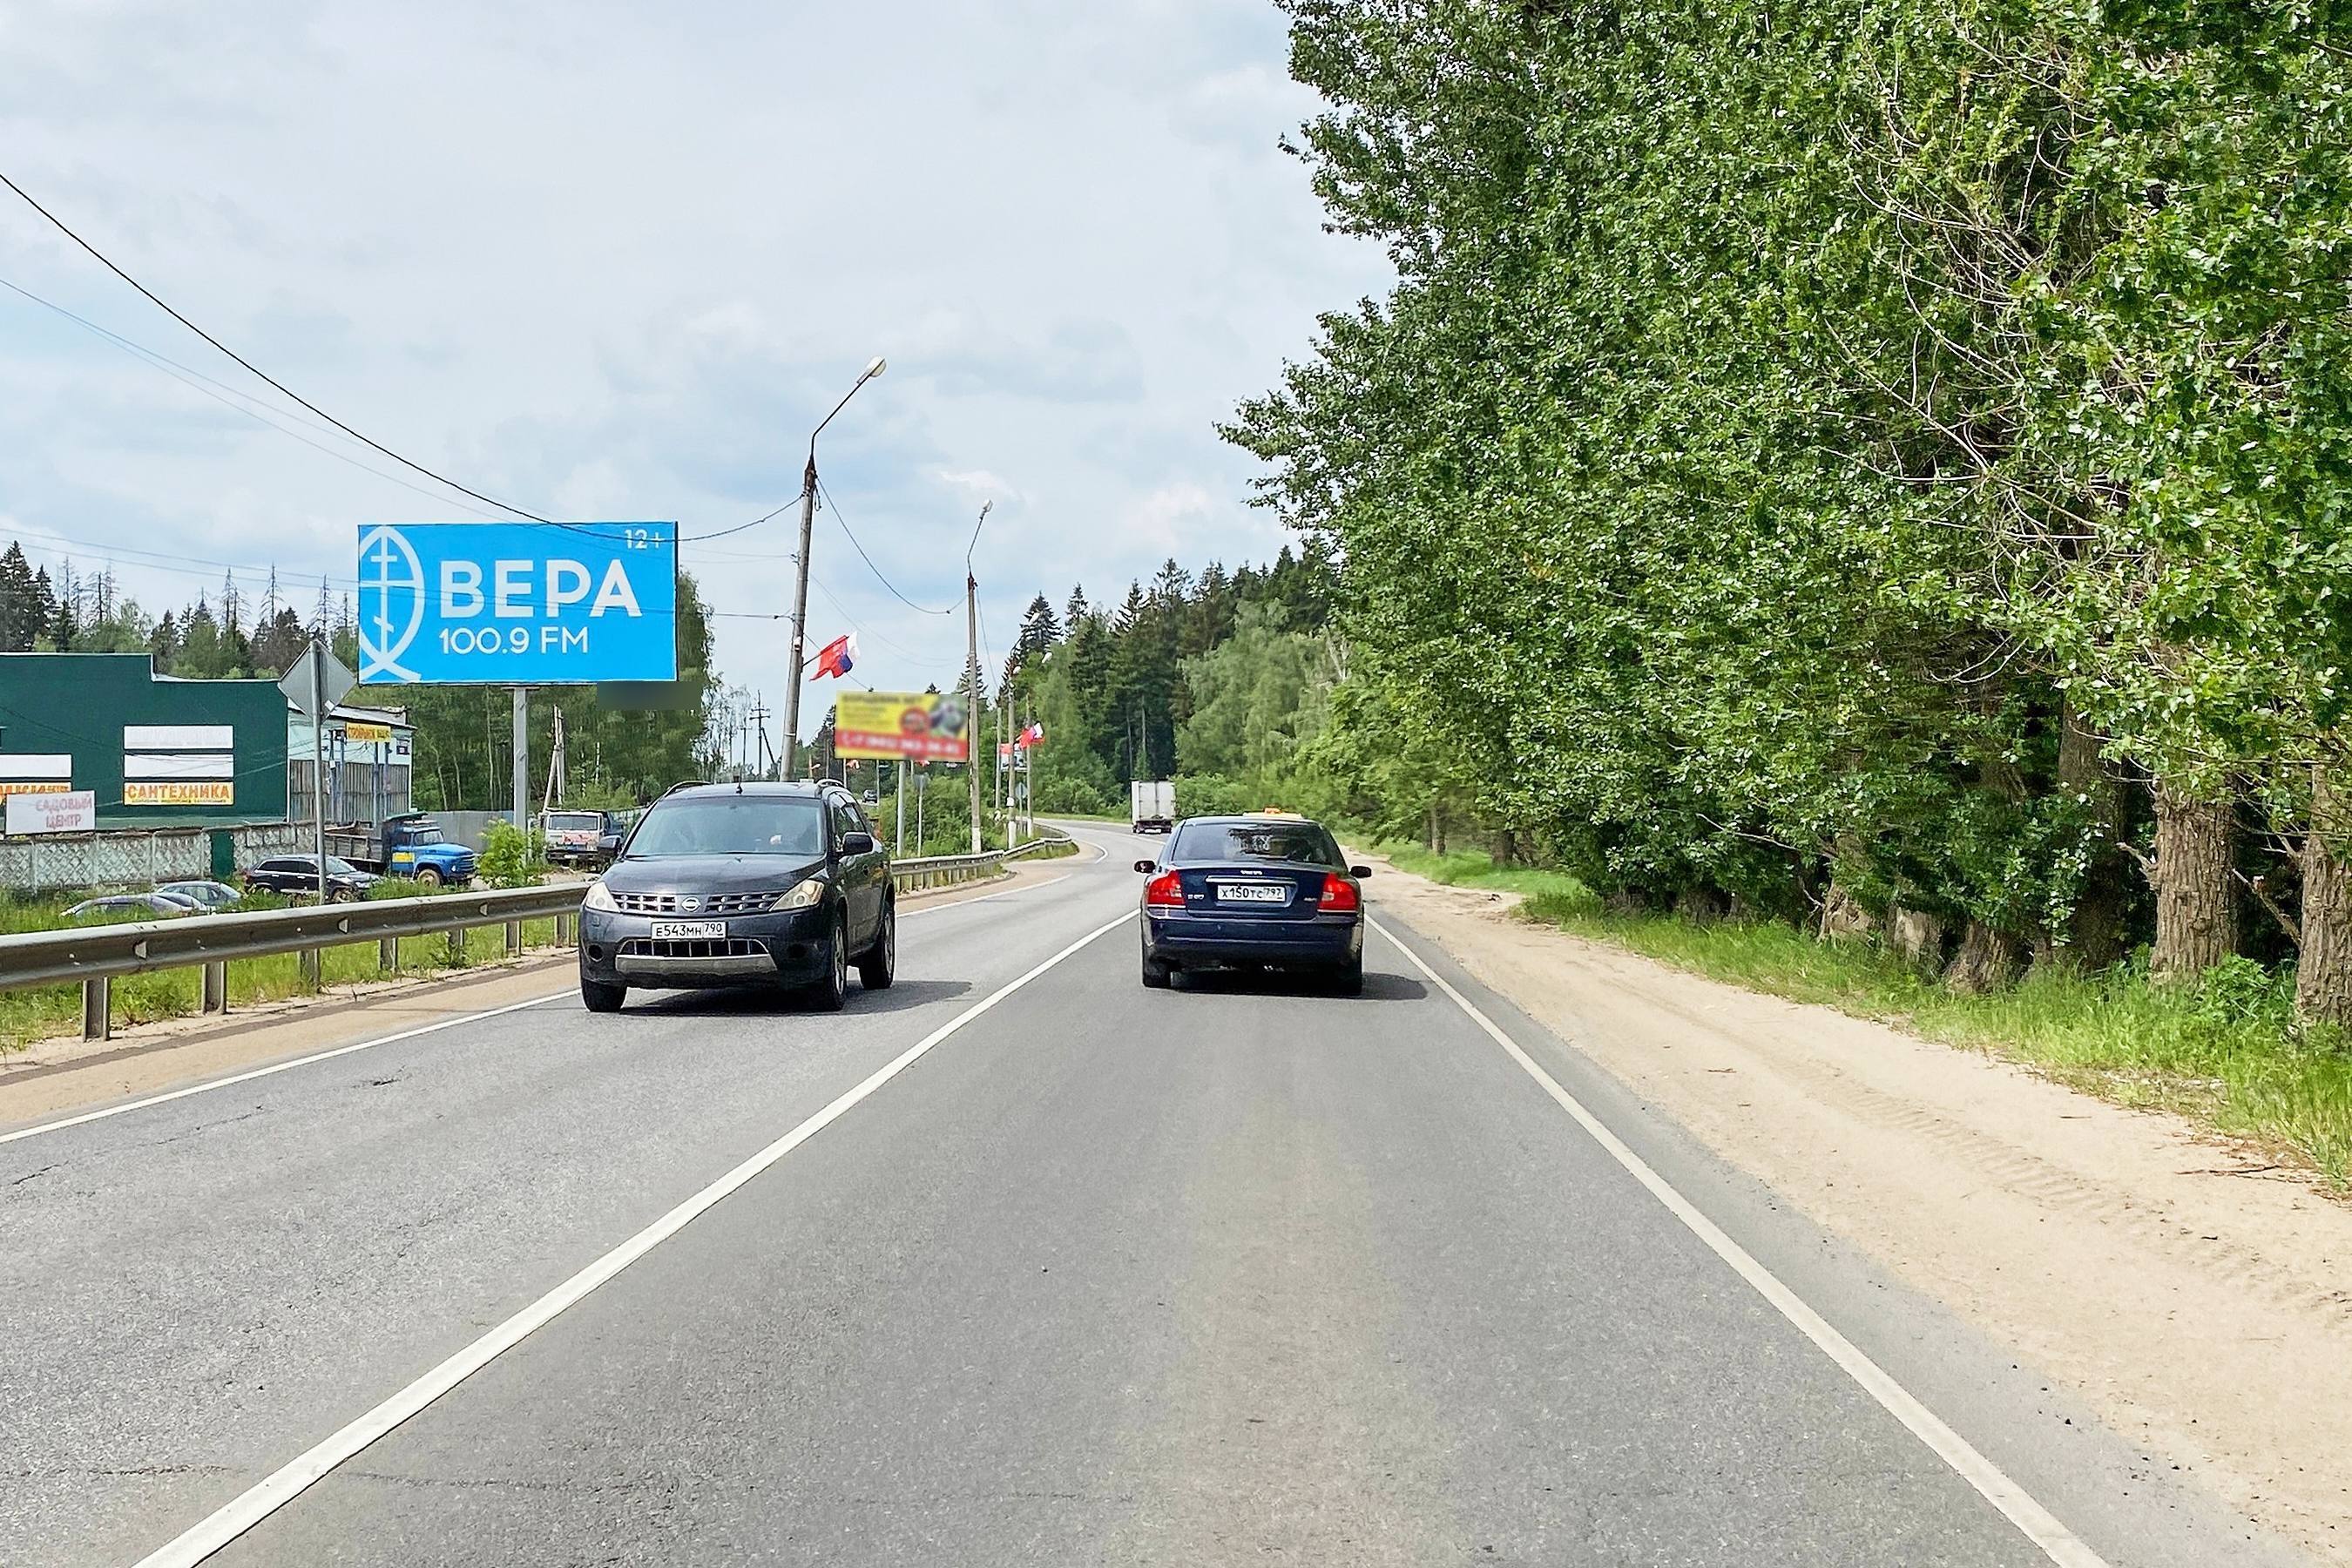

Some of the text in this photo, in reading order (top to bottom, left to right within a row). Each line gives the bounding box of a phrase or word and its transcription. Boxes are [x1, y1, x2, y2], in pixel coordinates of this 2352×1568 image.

[624, 529, 666, 549] 12+
[440, 558, 643, 618] ВЕРА
[438, 626, 589, 654] 100.9 FM
[128, 784, 230, 799] САНТЕХНИКА
[36, 794, 92, 814] САДОВЫЙ
[46, 814, 82, 829] ЦЕНТР
[656, 923, 722, 936] Е543МН 790
